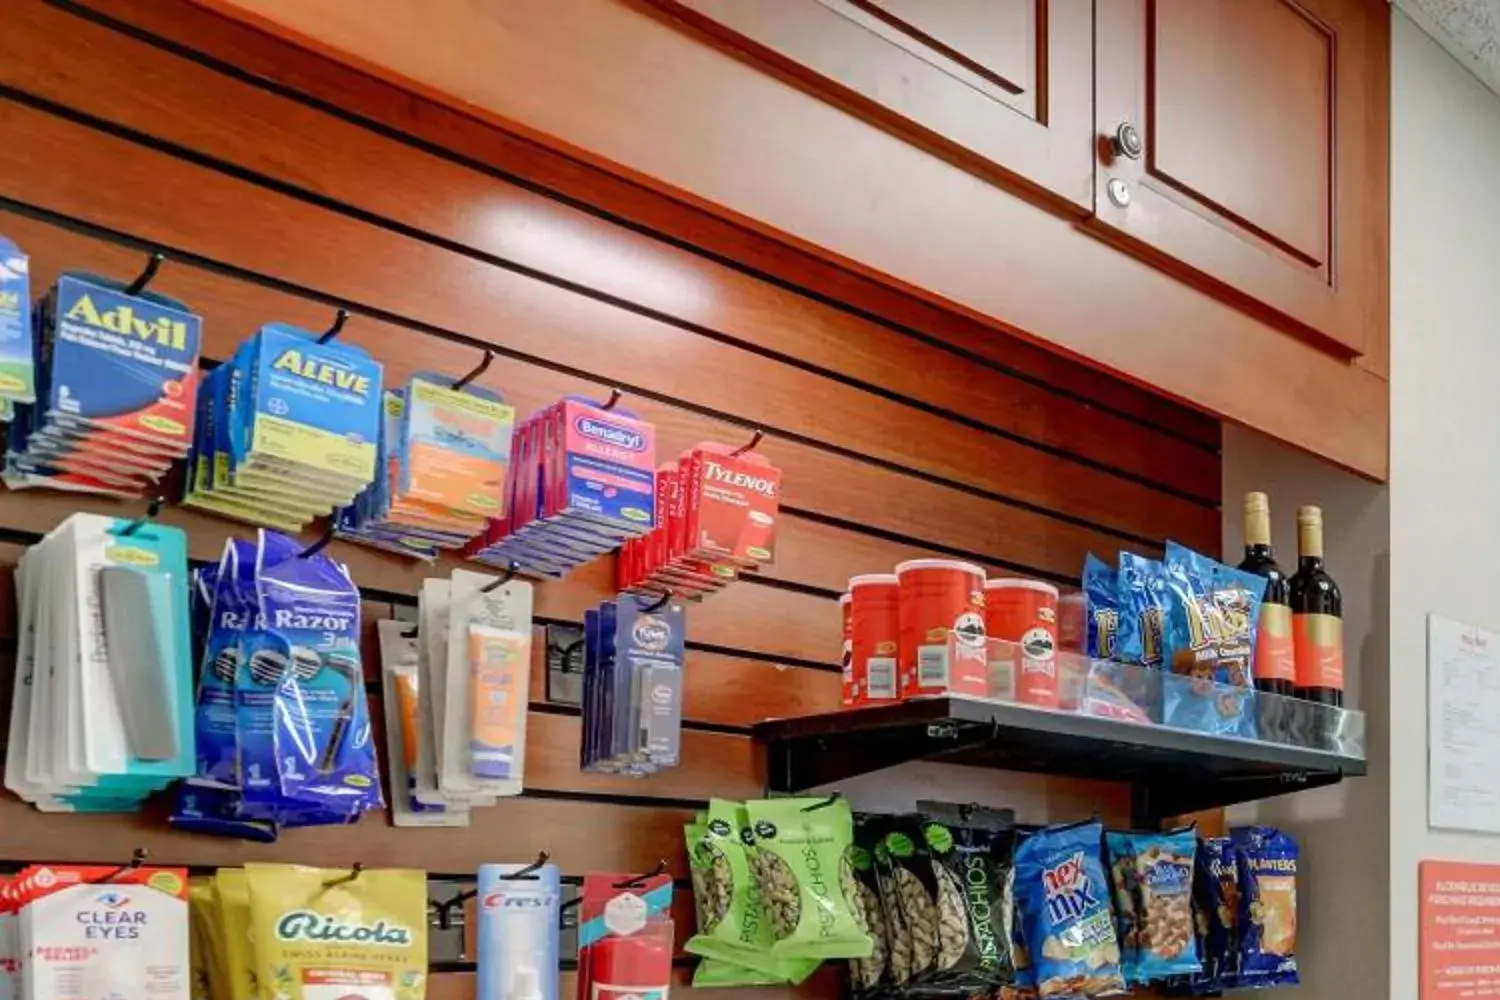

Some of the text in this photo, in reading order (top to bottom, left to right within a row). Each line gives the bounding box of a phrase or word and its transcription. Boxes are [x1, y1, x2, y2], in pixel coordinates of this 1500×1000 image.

[64, 293, 186, 351] Advil
[273, 348, 371, 396] ALEVE
[582, 420, 642, 448] Benadryl
[704, 460, 777, 498] TYLENOL
[275, 609, 351, 631] Razor
[483, 893, 559, 911] Crest
[76, 911, 148, 925] CLEAR
[278, 912, 409, 944] Ricola
[85, 926, 140, 939] EYES
